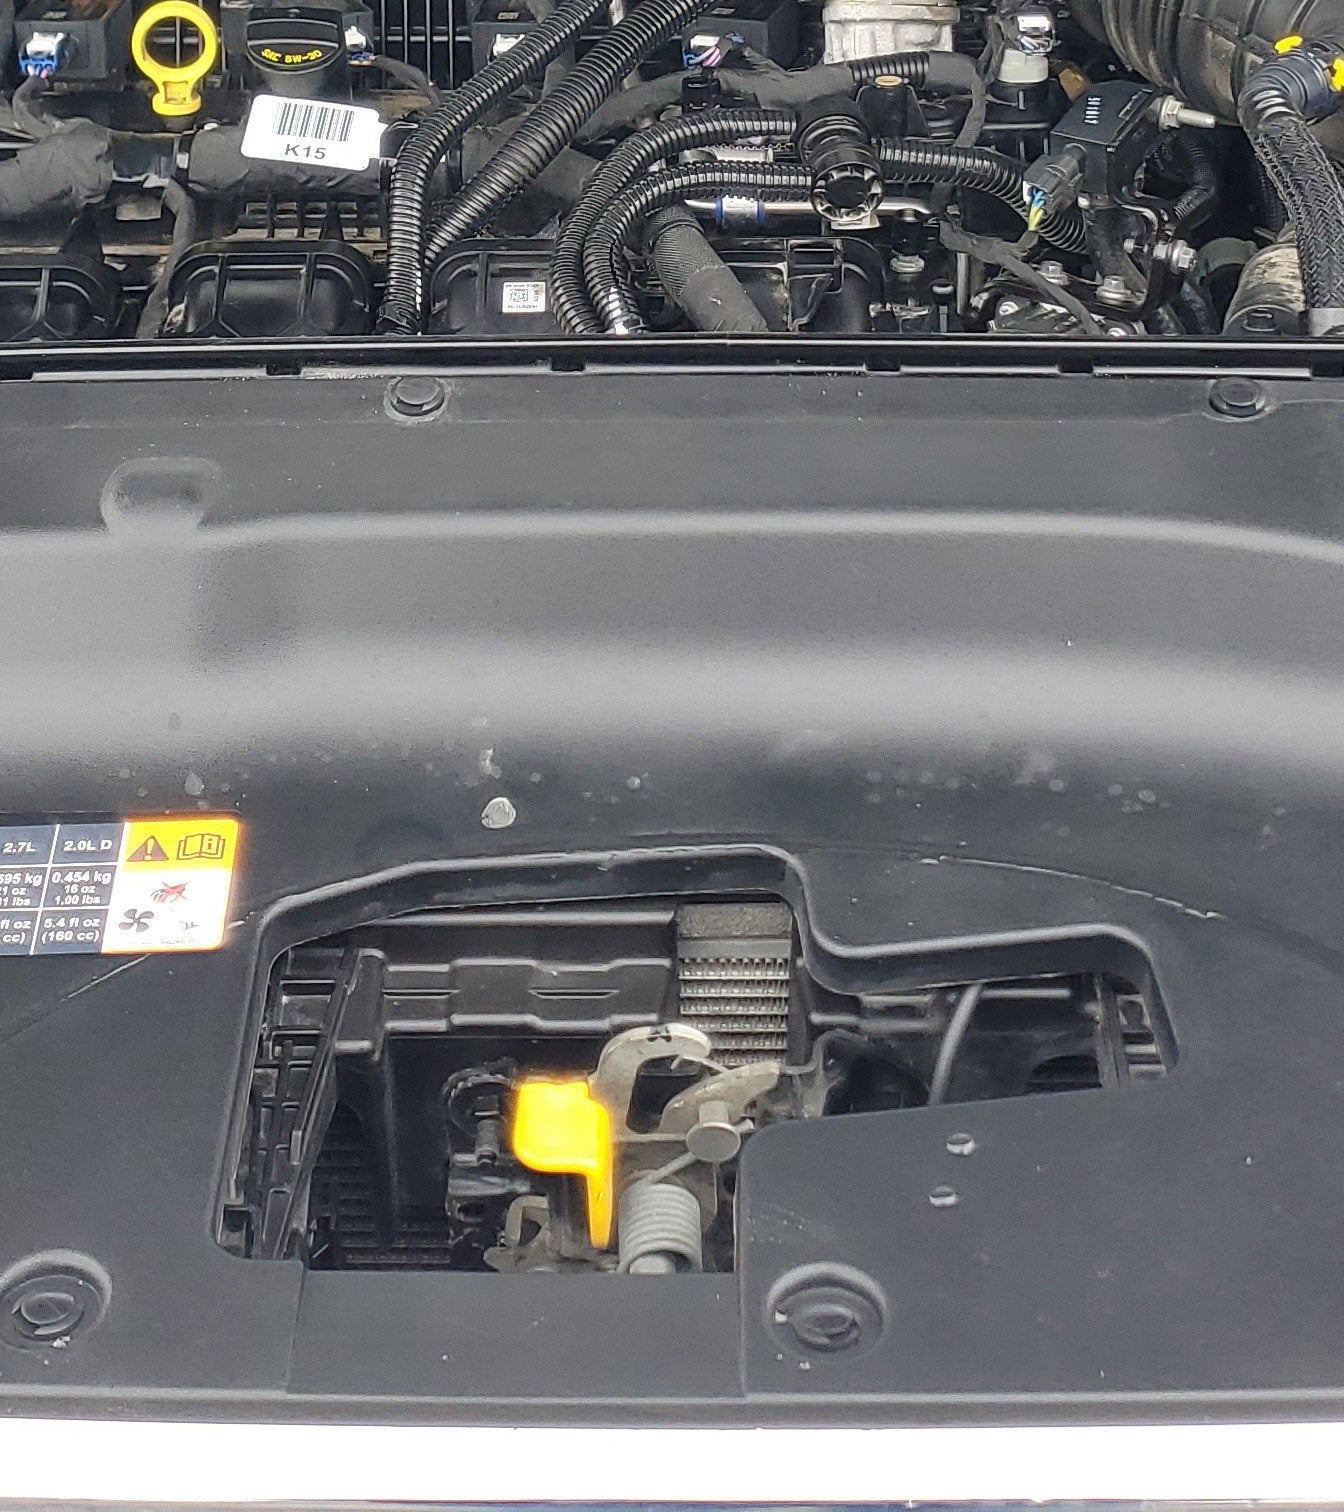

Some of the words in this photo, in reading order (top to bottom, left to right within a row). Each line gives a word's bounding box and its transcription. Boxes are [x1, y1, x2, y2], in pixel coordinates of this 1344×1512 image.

[284, 144, 326, 160] K15
[3, 842, 36, 853] 2.7L
[64, 840, 96, 851] 2.0L
[100, 840, 112, 850] D
[24, 872, 43, 886] kg
[52, 871, 90, 884] 0.454
[94, 870, 112, 884] kg
[80, 886, 96, 894] oz
[12, 897, 31, 906] lbs
[82, 895, 100, 904] lbs
[14, 920, 32, 928] oz
[83, 918, 100, 927] oz
[3, 932, 26, 944] cc)
[42, 930, 73, 944] (160
[76, 930, 100, 942] cc)
